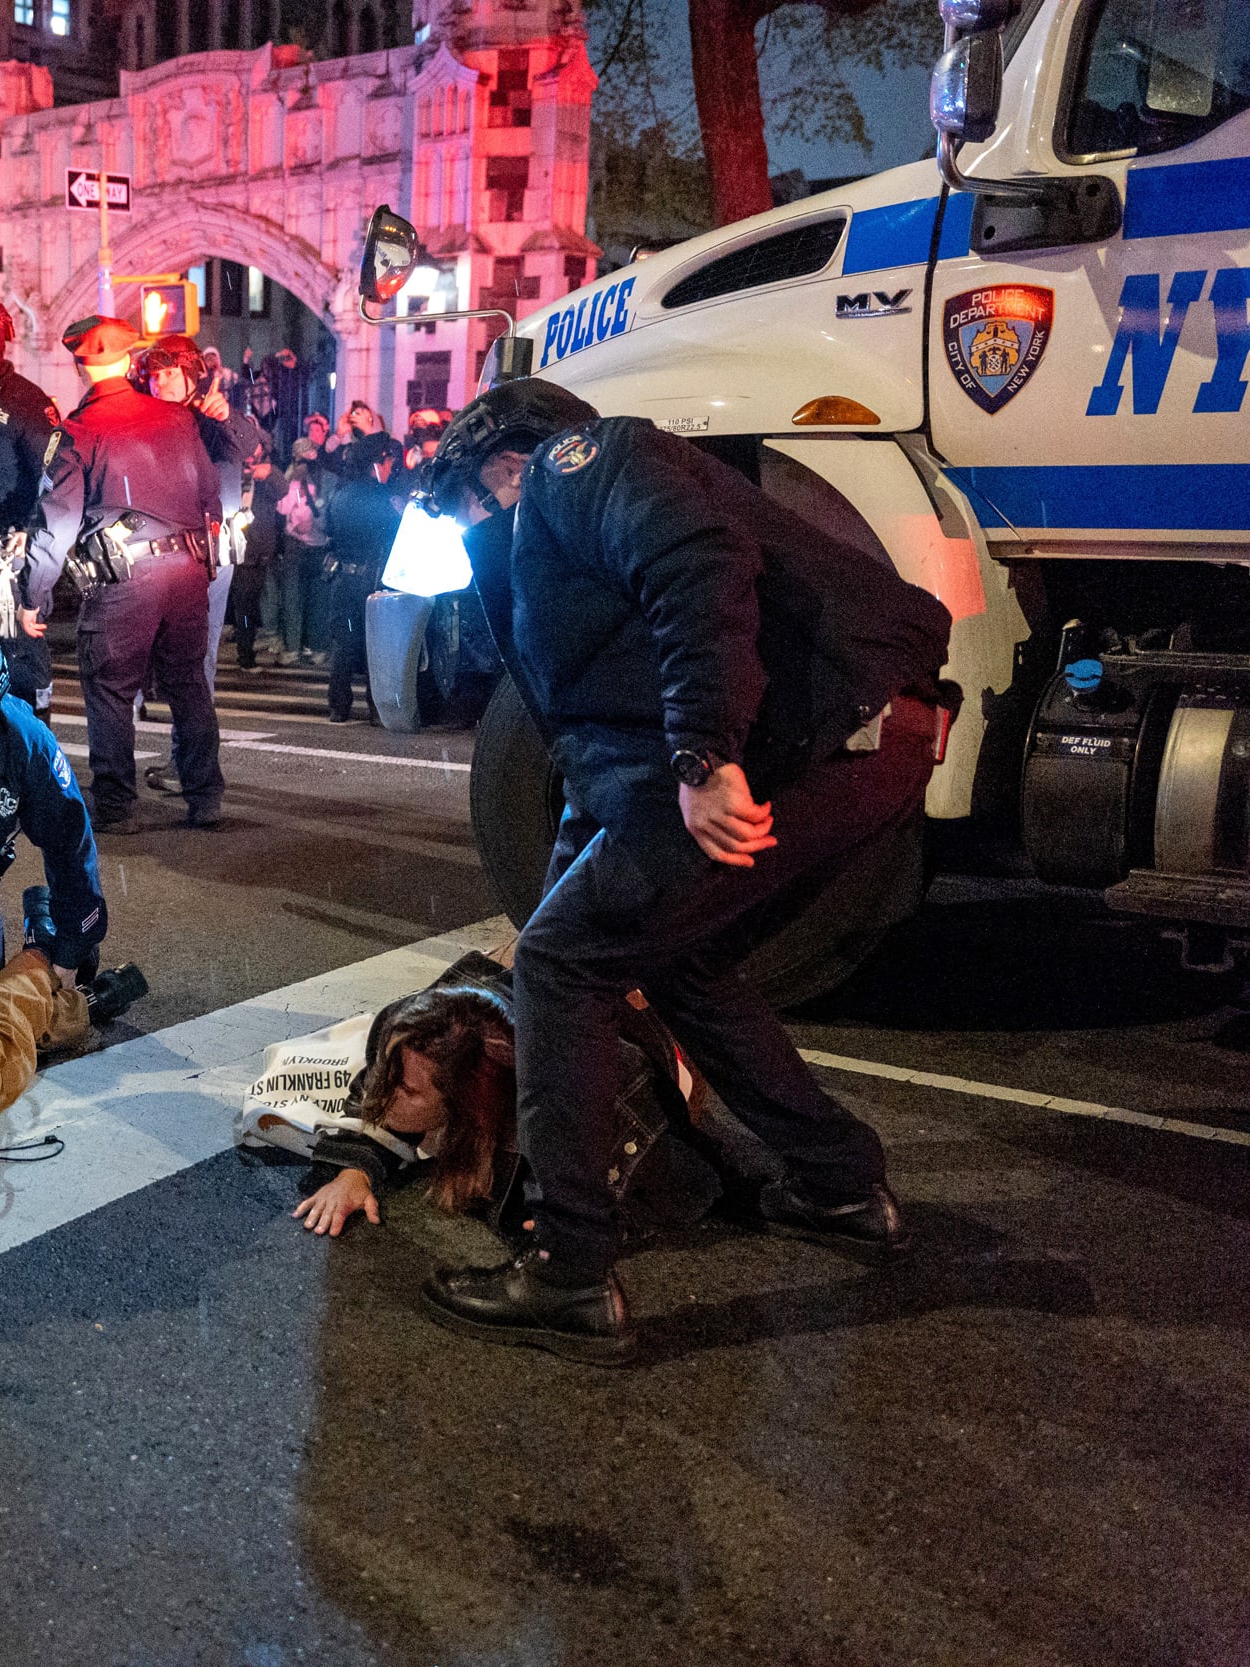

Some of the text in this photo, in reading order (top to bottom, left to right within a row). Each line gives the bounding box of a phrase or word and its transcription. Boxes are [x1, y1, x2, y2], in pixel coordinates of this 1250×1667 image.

[77, 182, 96, 198] ONE
[835, 289, 913, 312] MV
[972, 289, 1024, 306] POLICE
[540, 276, 637, 368] POLICE
[950, 303, 1046, 329] DEPARTMENT
[948, 341, 977, 389] CITY OF
[1007, 330, 1045, 392] NEW YORK
[660, 423, 701, 431] 75/80R22.5
[1061, 736, 1111, 747] DEF FLUID
[1070, 746, 1097, 755] ONLY
[250, 1069, 352, 1096] 49 FRANKLIN ST
